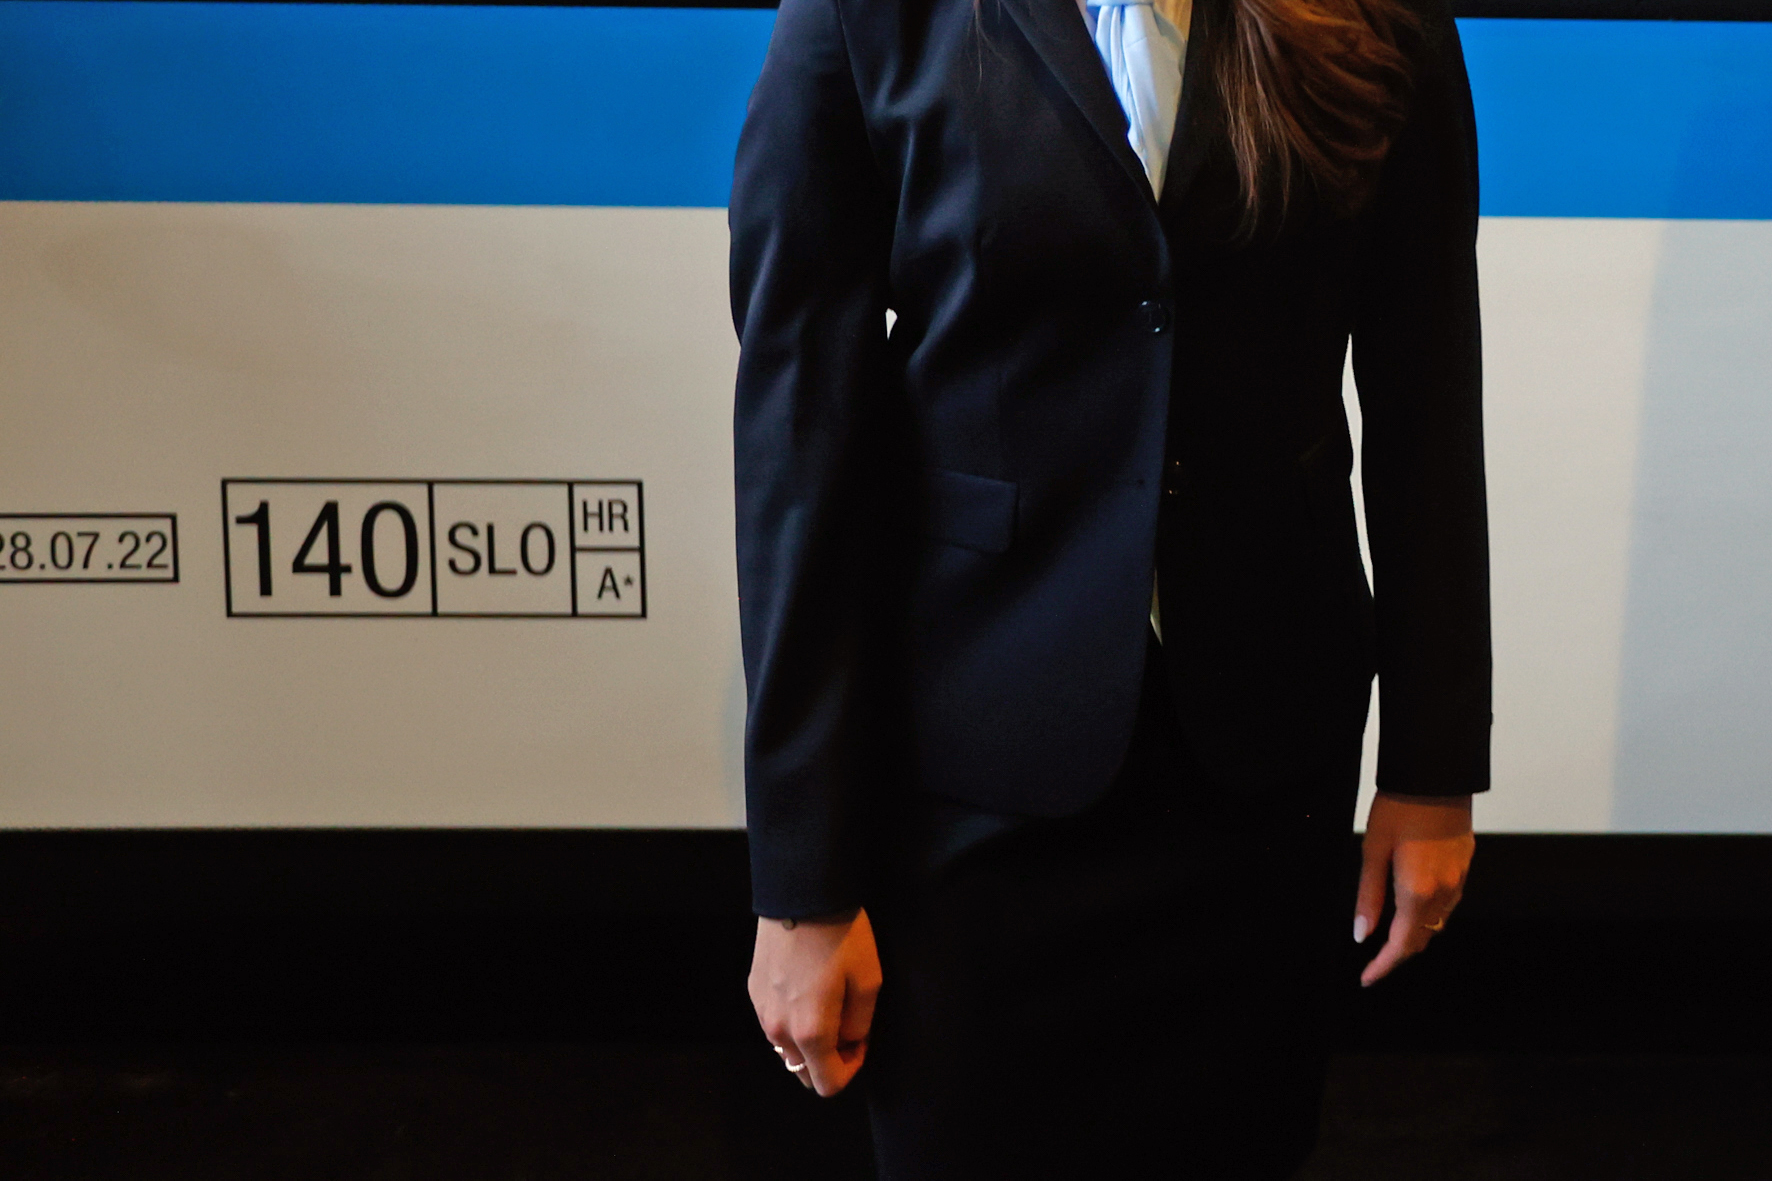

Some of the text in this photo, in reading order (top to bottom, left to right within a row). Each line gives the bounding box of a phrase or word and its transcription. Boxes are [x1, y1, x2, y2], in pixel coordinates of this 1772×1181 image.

[582, 499, 629, 533] HR
[0, 530, 169, 571] 8.07.22
[234, 499, 419, 600] 140
[447, 521, 556, 577] SLO
